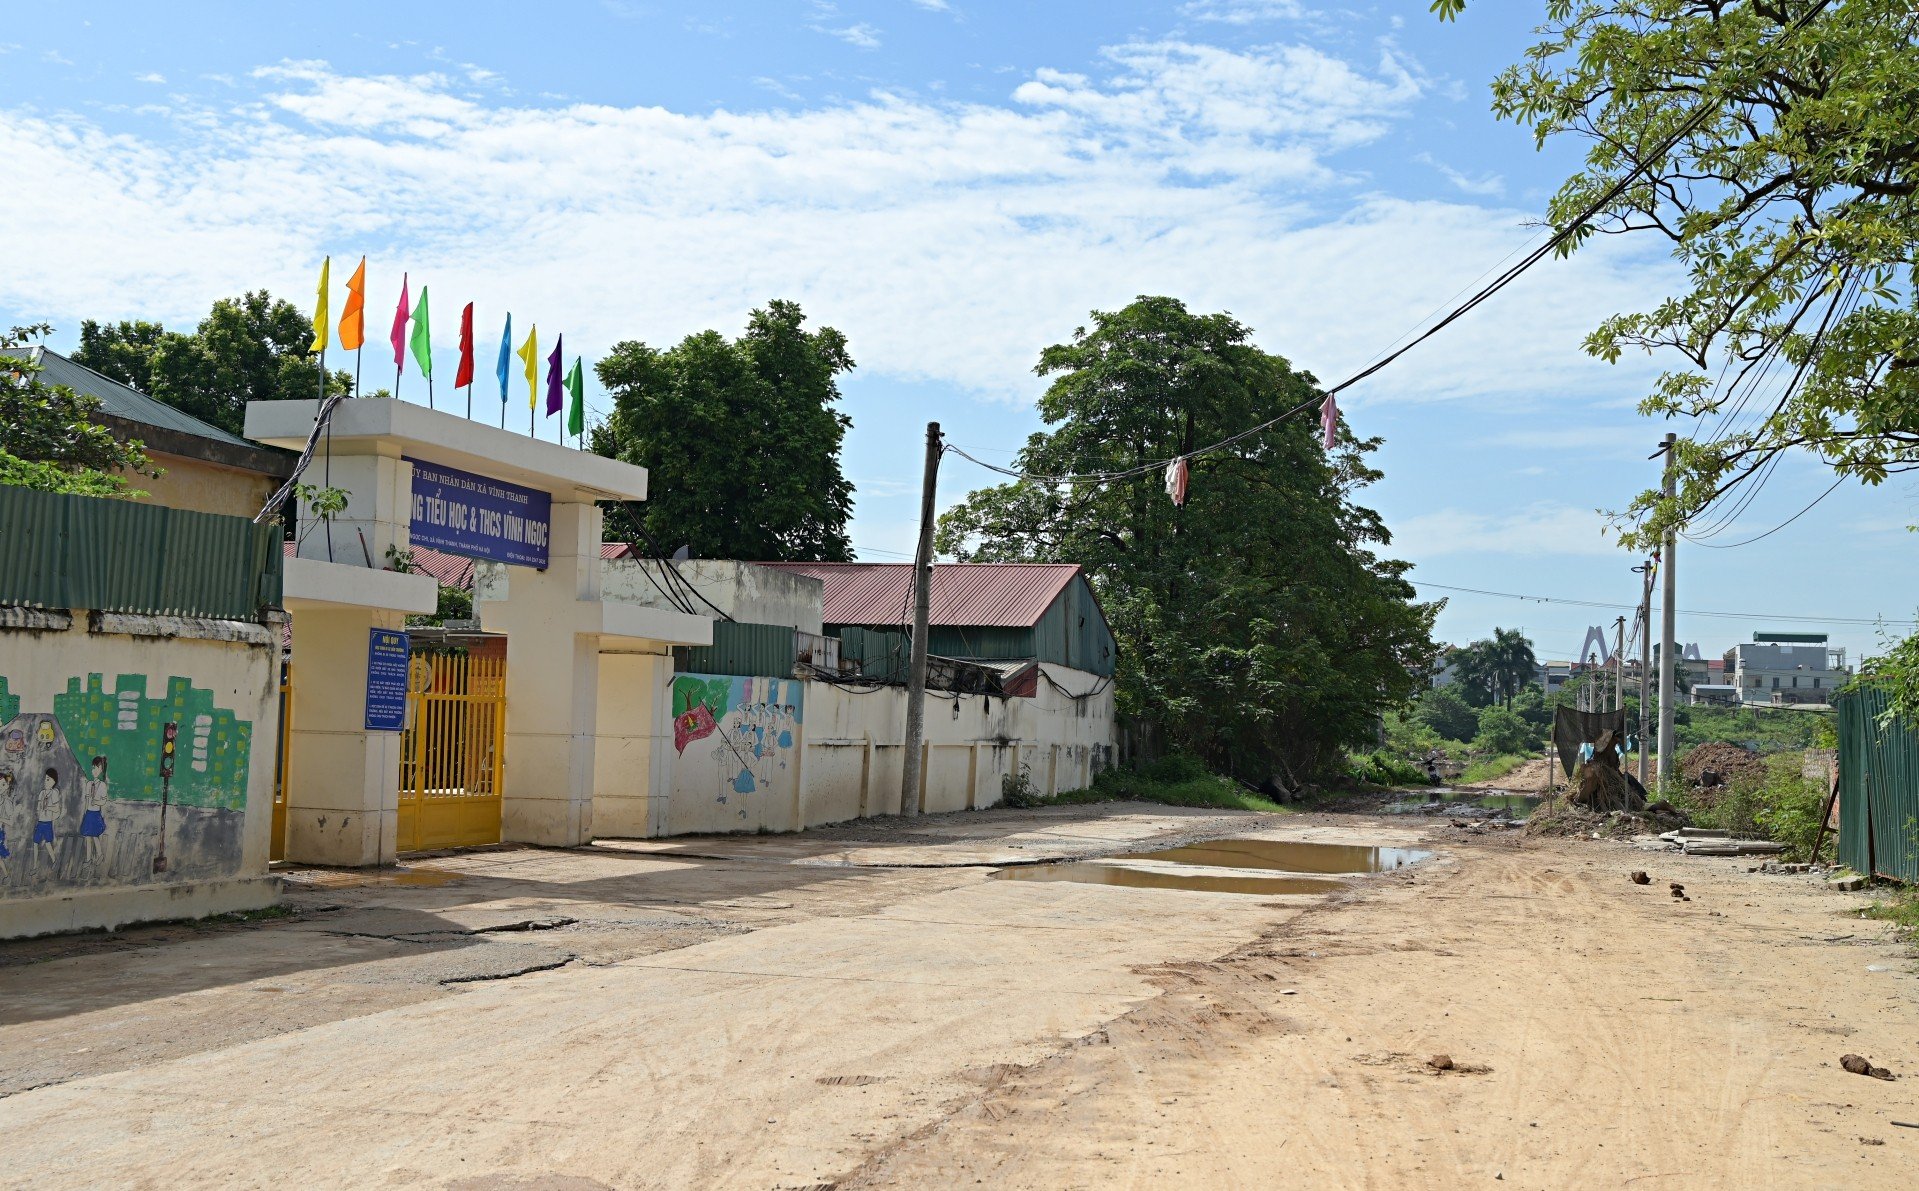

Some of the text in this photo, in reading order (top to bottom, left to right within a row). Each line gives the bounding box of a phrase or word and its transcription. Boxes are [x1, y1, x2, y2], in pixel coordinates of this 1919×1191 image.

[422, 470, 438, 482] BAN
[439, 475, 460, 488] NHÂN
[461, 479, 476, 491] DÂN
[477, 484, 487, 496] XÃ
[488, 486, 505, 499] VĨNH
[506, 491, 528, 504] THANH
[410, 488, 548, 552] NG TIỂU HỌC & THCS VĨNH NGỌC
